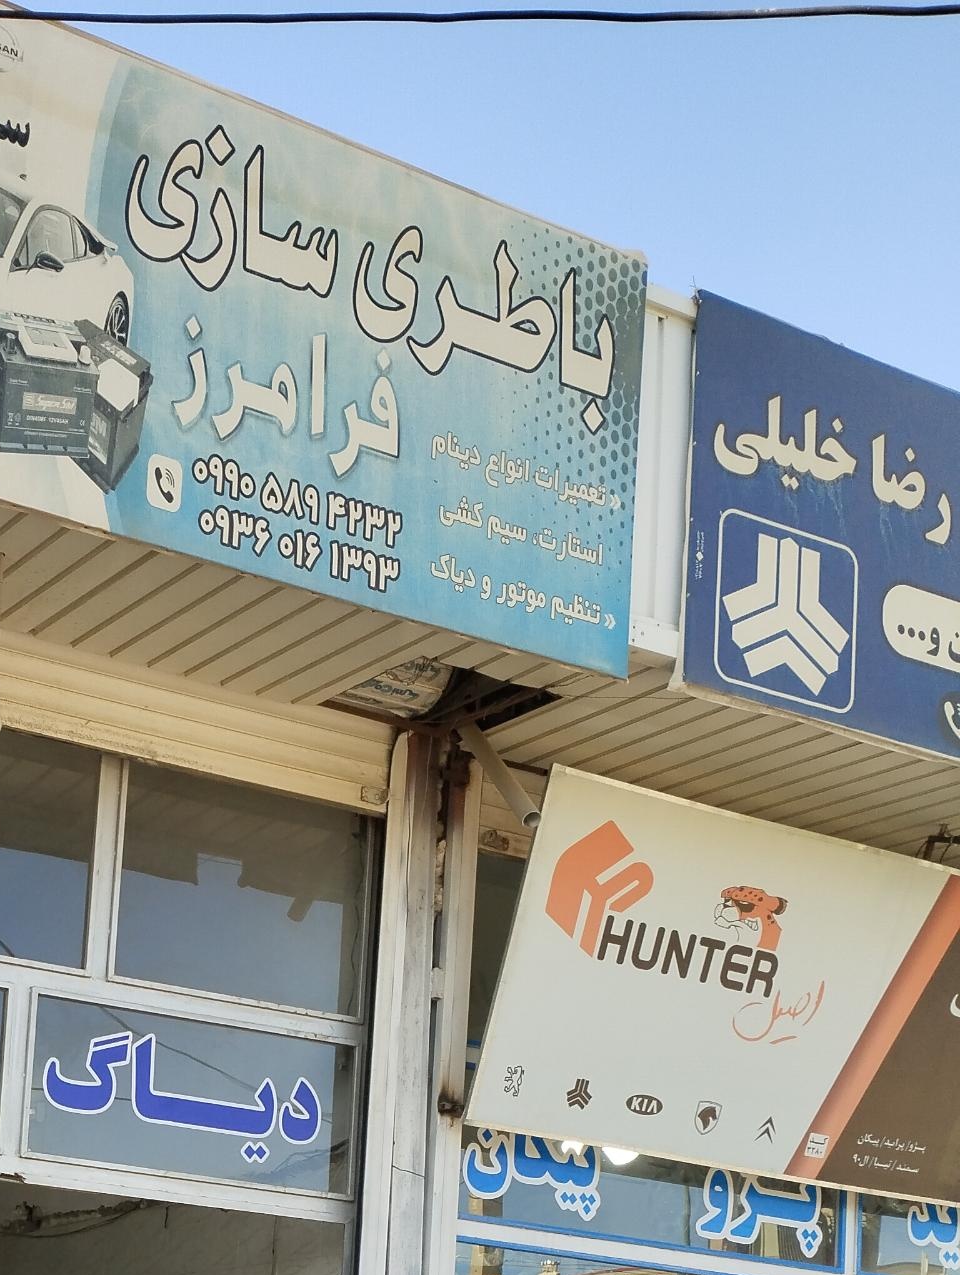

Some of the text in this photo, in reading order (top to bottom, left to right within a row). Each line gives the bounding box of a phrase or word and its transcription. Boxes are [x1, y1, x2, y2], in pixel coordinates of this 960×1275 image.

[125, 125, 615, 434] باطری سازی
[171, 315, 401, 478] فرامرز
[192, 453, 403, 548] ۰۹۹۰ ۵۸۹ ۴۲۳۲
[431, 431, 607, 507] تعمیرات انواع دینام
[713, 396, 952, 545] رضا خلیلی
[198, 505, 401, 592] ۰۹۳۶ ۰۱۶ ۱۳۹۳
[439, 496, 483, 528] کشی
[487, 515, 527, 545] سیم
[480, 575, 492, 600] و
[496, 581, 546, 613] موتور
[550, 594, 601, 625] تنظیم
[596, 914, 779, 998] HUNTER
[41, 1030, 323, 1164] دیاگ
[629, 1096, 659, 1114] KIA
